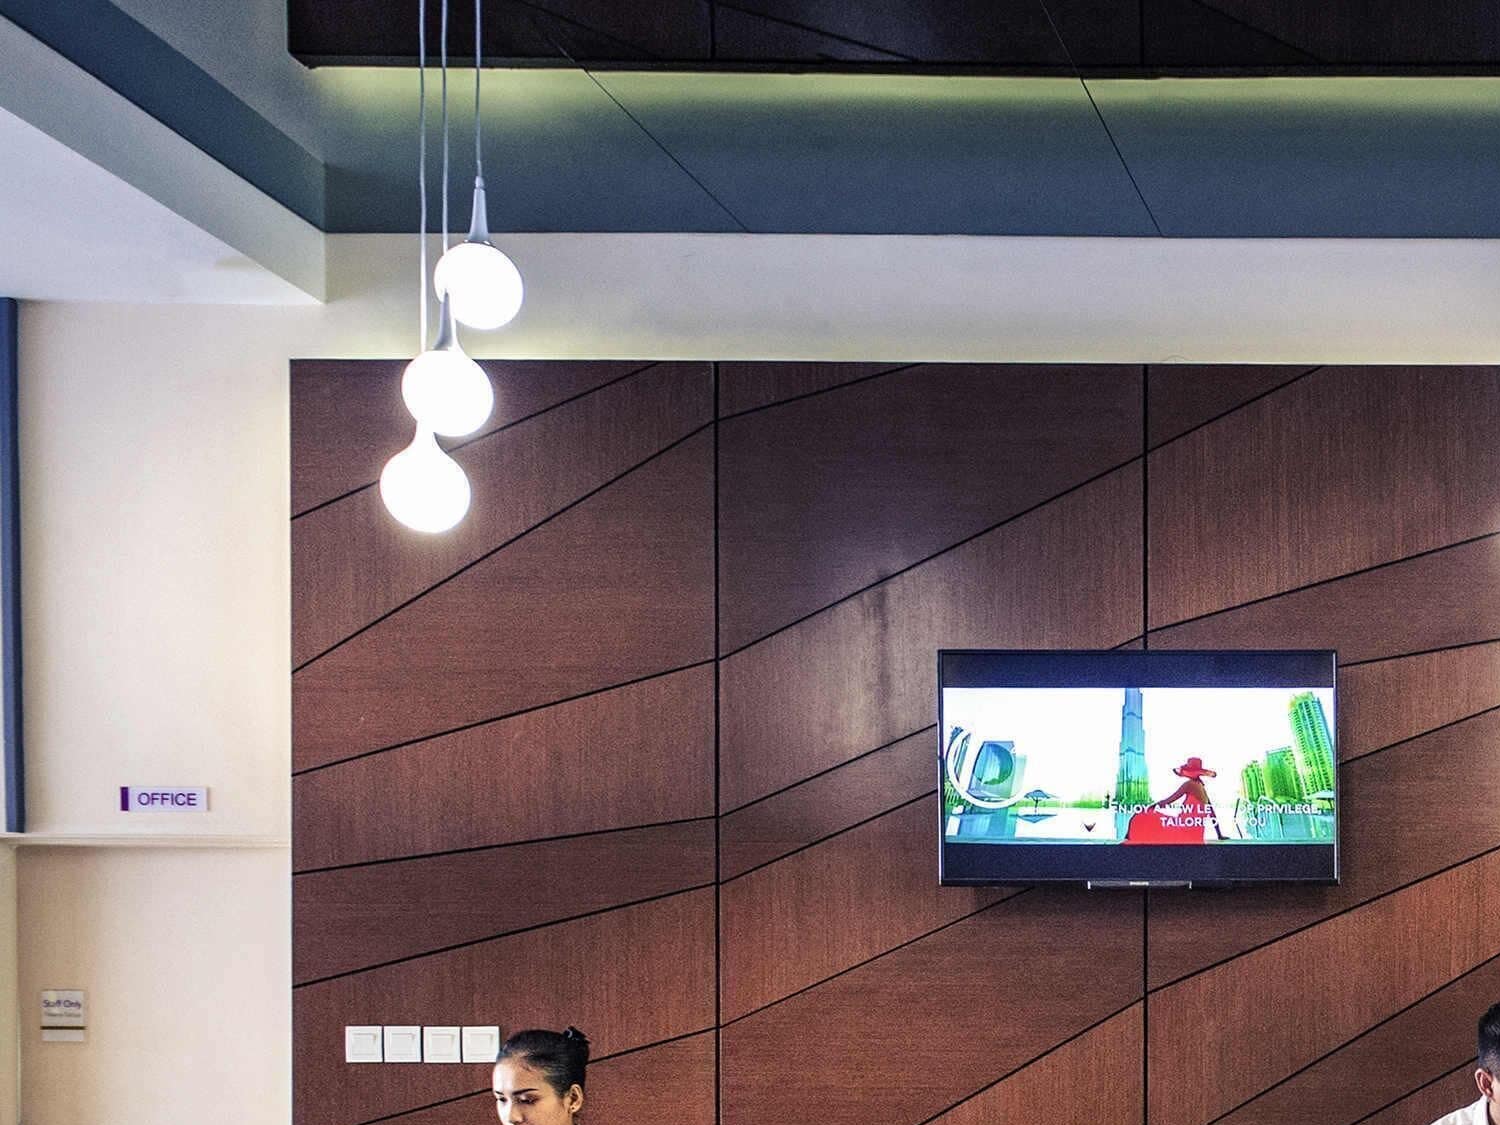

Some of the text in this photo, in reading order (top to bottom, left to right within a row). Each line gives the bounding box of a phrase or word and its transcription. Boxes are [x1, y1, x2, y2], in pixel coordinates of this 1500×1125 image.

[137, 792, 197, 806] OFFICE
[1110, 804, 1150, 814] ENJOY
[1160, 816, 1217, 827] TAILORED
[1242, 817, 1266, 827] OU
